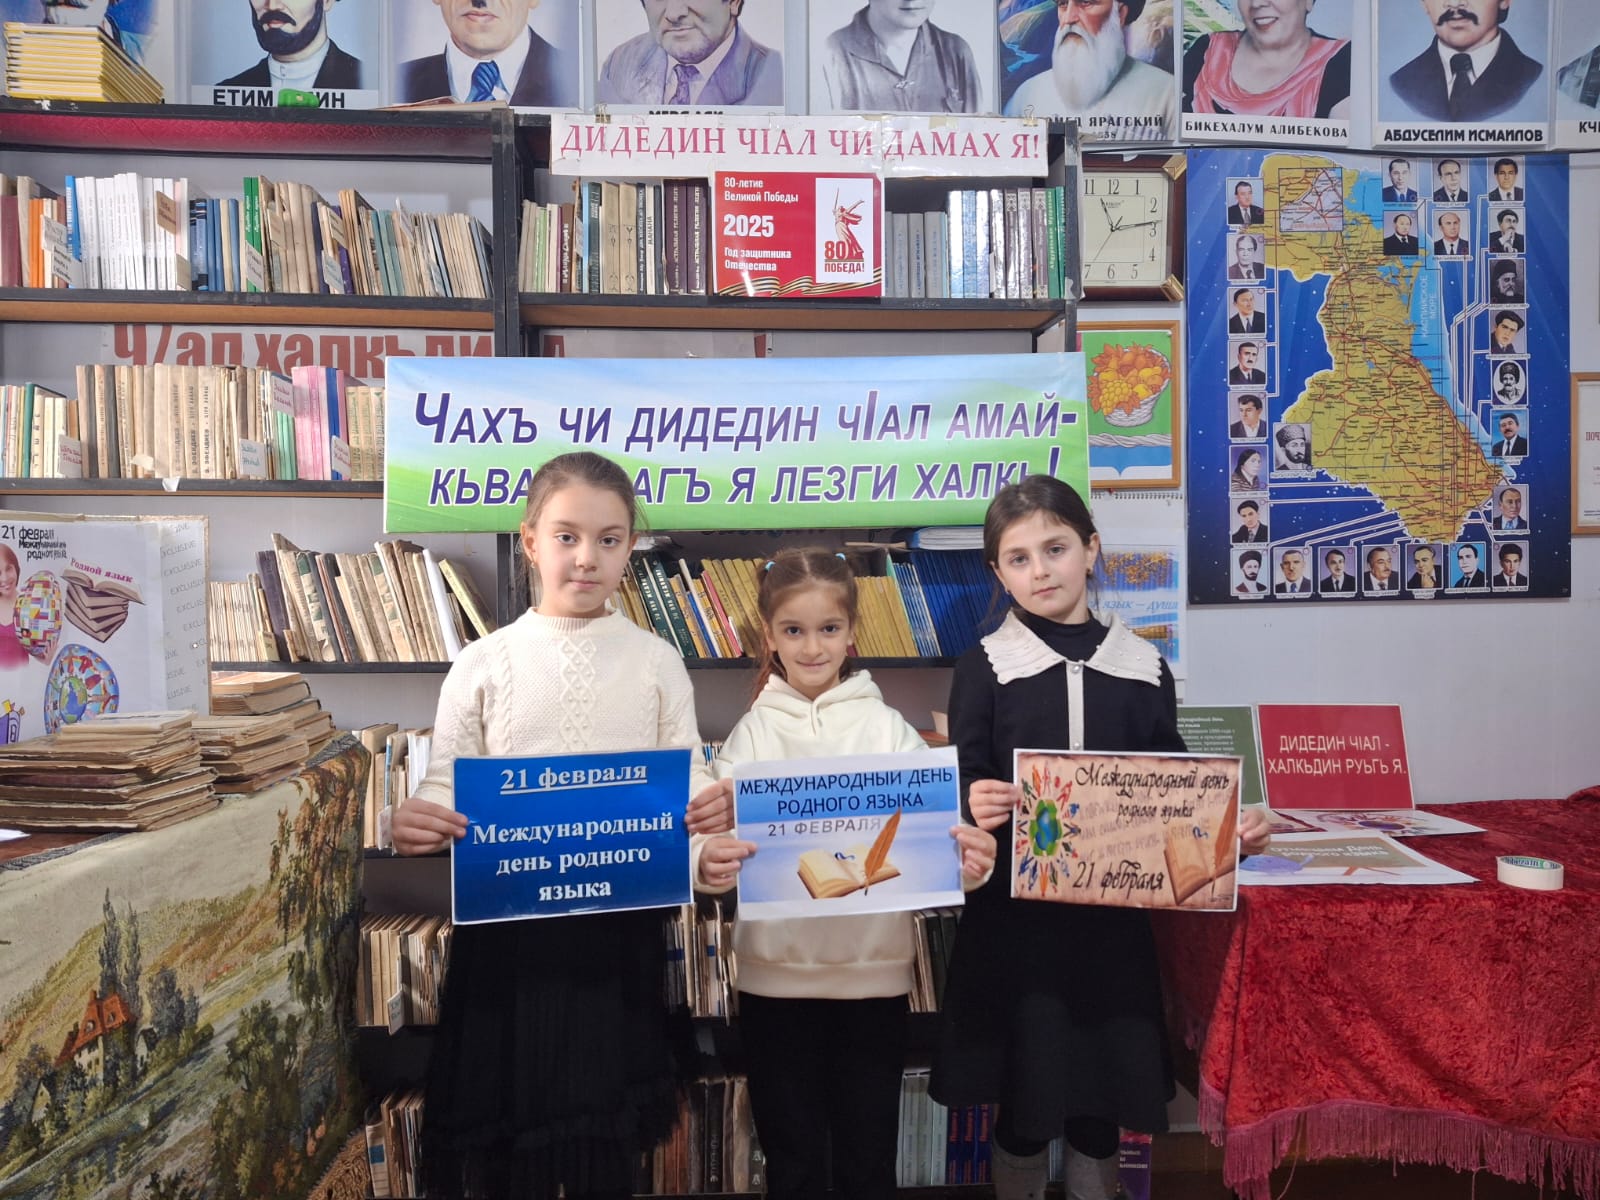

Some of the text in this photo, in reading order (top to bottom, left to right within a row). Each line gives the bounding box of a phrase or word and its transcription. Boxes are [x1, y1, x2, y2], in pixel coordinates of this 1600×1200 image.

[213, 89, 273, 107] ЕТИМ
[1089, 115, 1163, 127] ЯРАГСКИЙ
[1185, 121, 1348, 138] БИКЕХАЛУМ АЛИБЕКОВА
[1579, 121, 1600, 133] КЧ
[561, 125, 726, 160] ДИДЕДИН
[828, 130, 873, 156] ЧИ
[884, 130, 1001, 161] ДАМАХ
[1011, 134, 1039, 159] Я!
[1384, 129, 1465, 142] АБДУСЕЛИМ
[724, 177, 764, 189] 80-летие
[1084, 179, 1095, 195] 11
[1108, 179, 1120, 195] 12
[724, 191, 799, 203] Великой Победы
[1150, 197, 1157, 213] 2
[723, 214, 774, 237] 2025
[1149, 221, 1157, 237] 3
[724, 247, 792, 260] Год защитника
[824, 241, 847, 260] 80
[1148, 247, 1155, 262] 4
[824, 263, 865, 274] ПОБЕДА!
[1084, 264, 1138, 280] 7 6 5
[559, 407, 612, 444] ЧИ
[624, 404, 819, 452] ДИДЕДИН
[945, 392, 1077, 439] АМАЙ-
[428, 468, 533, 505] КЬВА
[633, 467, 711, 504] АГЪ
[727, 467, 757, 504] Я
[769, 464, 899, 503] ЛЕЗГИ
[1, 525, 16, 540] 21
[70, 557, 134, 583] Родной язык
[1280, 735, 1346, 754] ДИДЕДИН
[1267, 759, 1342, 776] ХАЛКЬДИН
[1346, 759, 1389, 774] РУЬГЬ
[500, 765, 648, 790] 21 февраля
[908, 767, 953, 787] ДЕНЬ
[1075, 762, 1198, 798] Международный
[778, 792, 924, 816] РОДНОГО ЯЗЫКА
[472, 812, 673, 845] Международный
[768, 818, 882, 837] 21 ФЕВРАЛЯ
[496, 847, 651, 876] день родного
[1072, 859, 1164, 899] 21 февраля
[538, 881, 612, 901] языка
